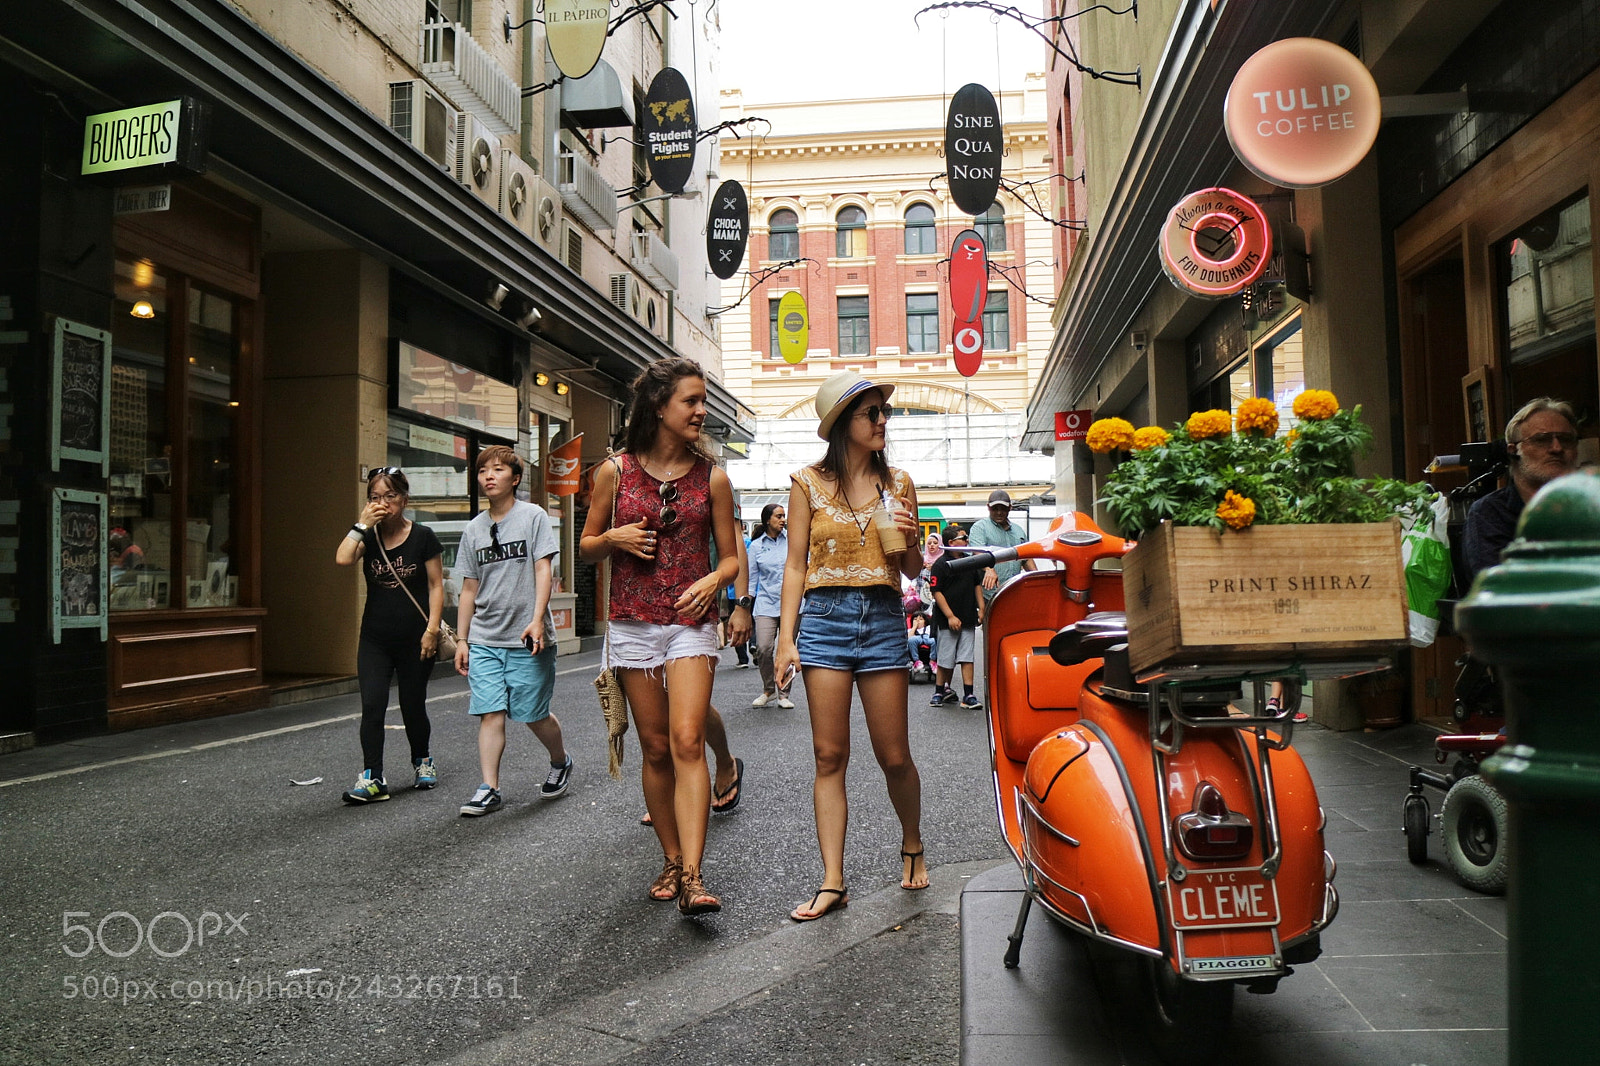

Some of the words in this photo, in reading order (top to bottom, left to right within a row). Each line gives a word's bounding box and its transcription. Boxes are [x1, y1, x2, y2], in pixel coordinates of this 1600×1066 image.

[549, 12, 560, 22] IL
[564, 8, 608, 21] PAPIRO
[1253, 84, 1351, 114] TULIP
[954, 113, 994, 129] SINE
[1256, 112, 1356, 137] COFFEE
[89, 110, 174, 165] BURGERS
[648, 129, 693, 142] Student
[651, 141, 690, 155] Flights
[954, 138, 993, 157] QUA
[953, 165, 994, 180] NON
[714, 217, 742, 230] CHOCA
[1175, 201, 1212, 230] Always
[1214, 201, 1224, 210] a
[712, 228, 741, 241] MAMA
[1178, 255, 1199, 277] FOR
[1199, 250, 1261, 283] DOUGHNUTS
[1209, 577, 1278, 594] PRINT
[1288, 574, 1373, 592] SHIRAZ
[1206, 873, 1237, 883] VIC
[1180, 884, 1269, 920] CLEME
[1198, 959, 1267, 969] PIAGGIO
